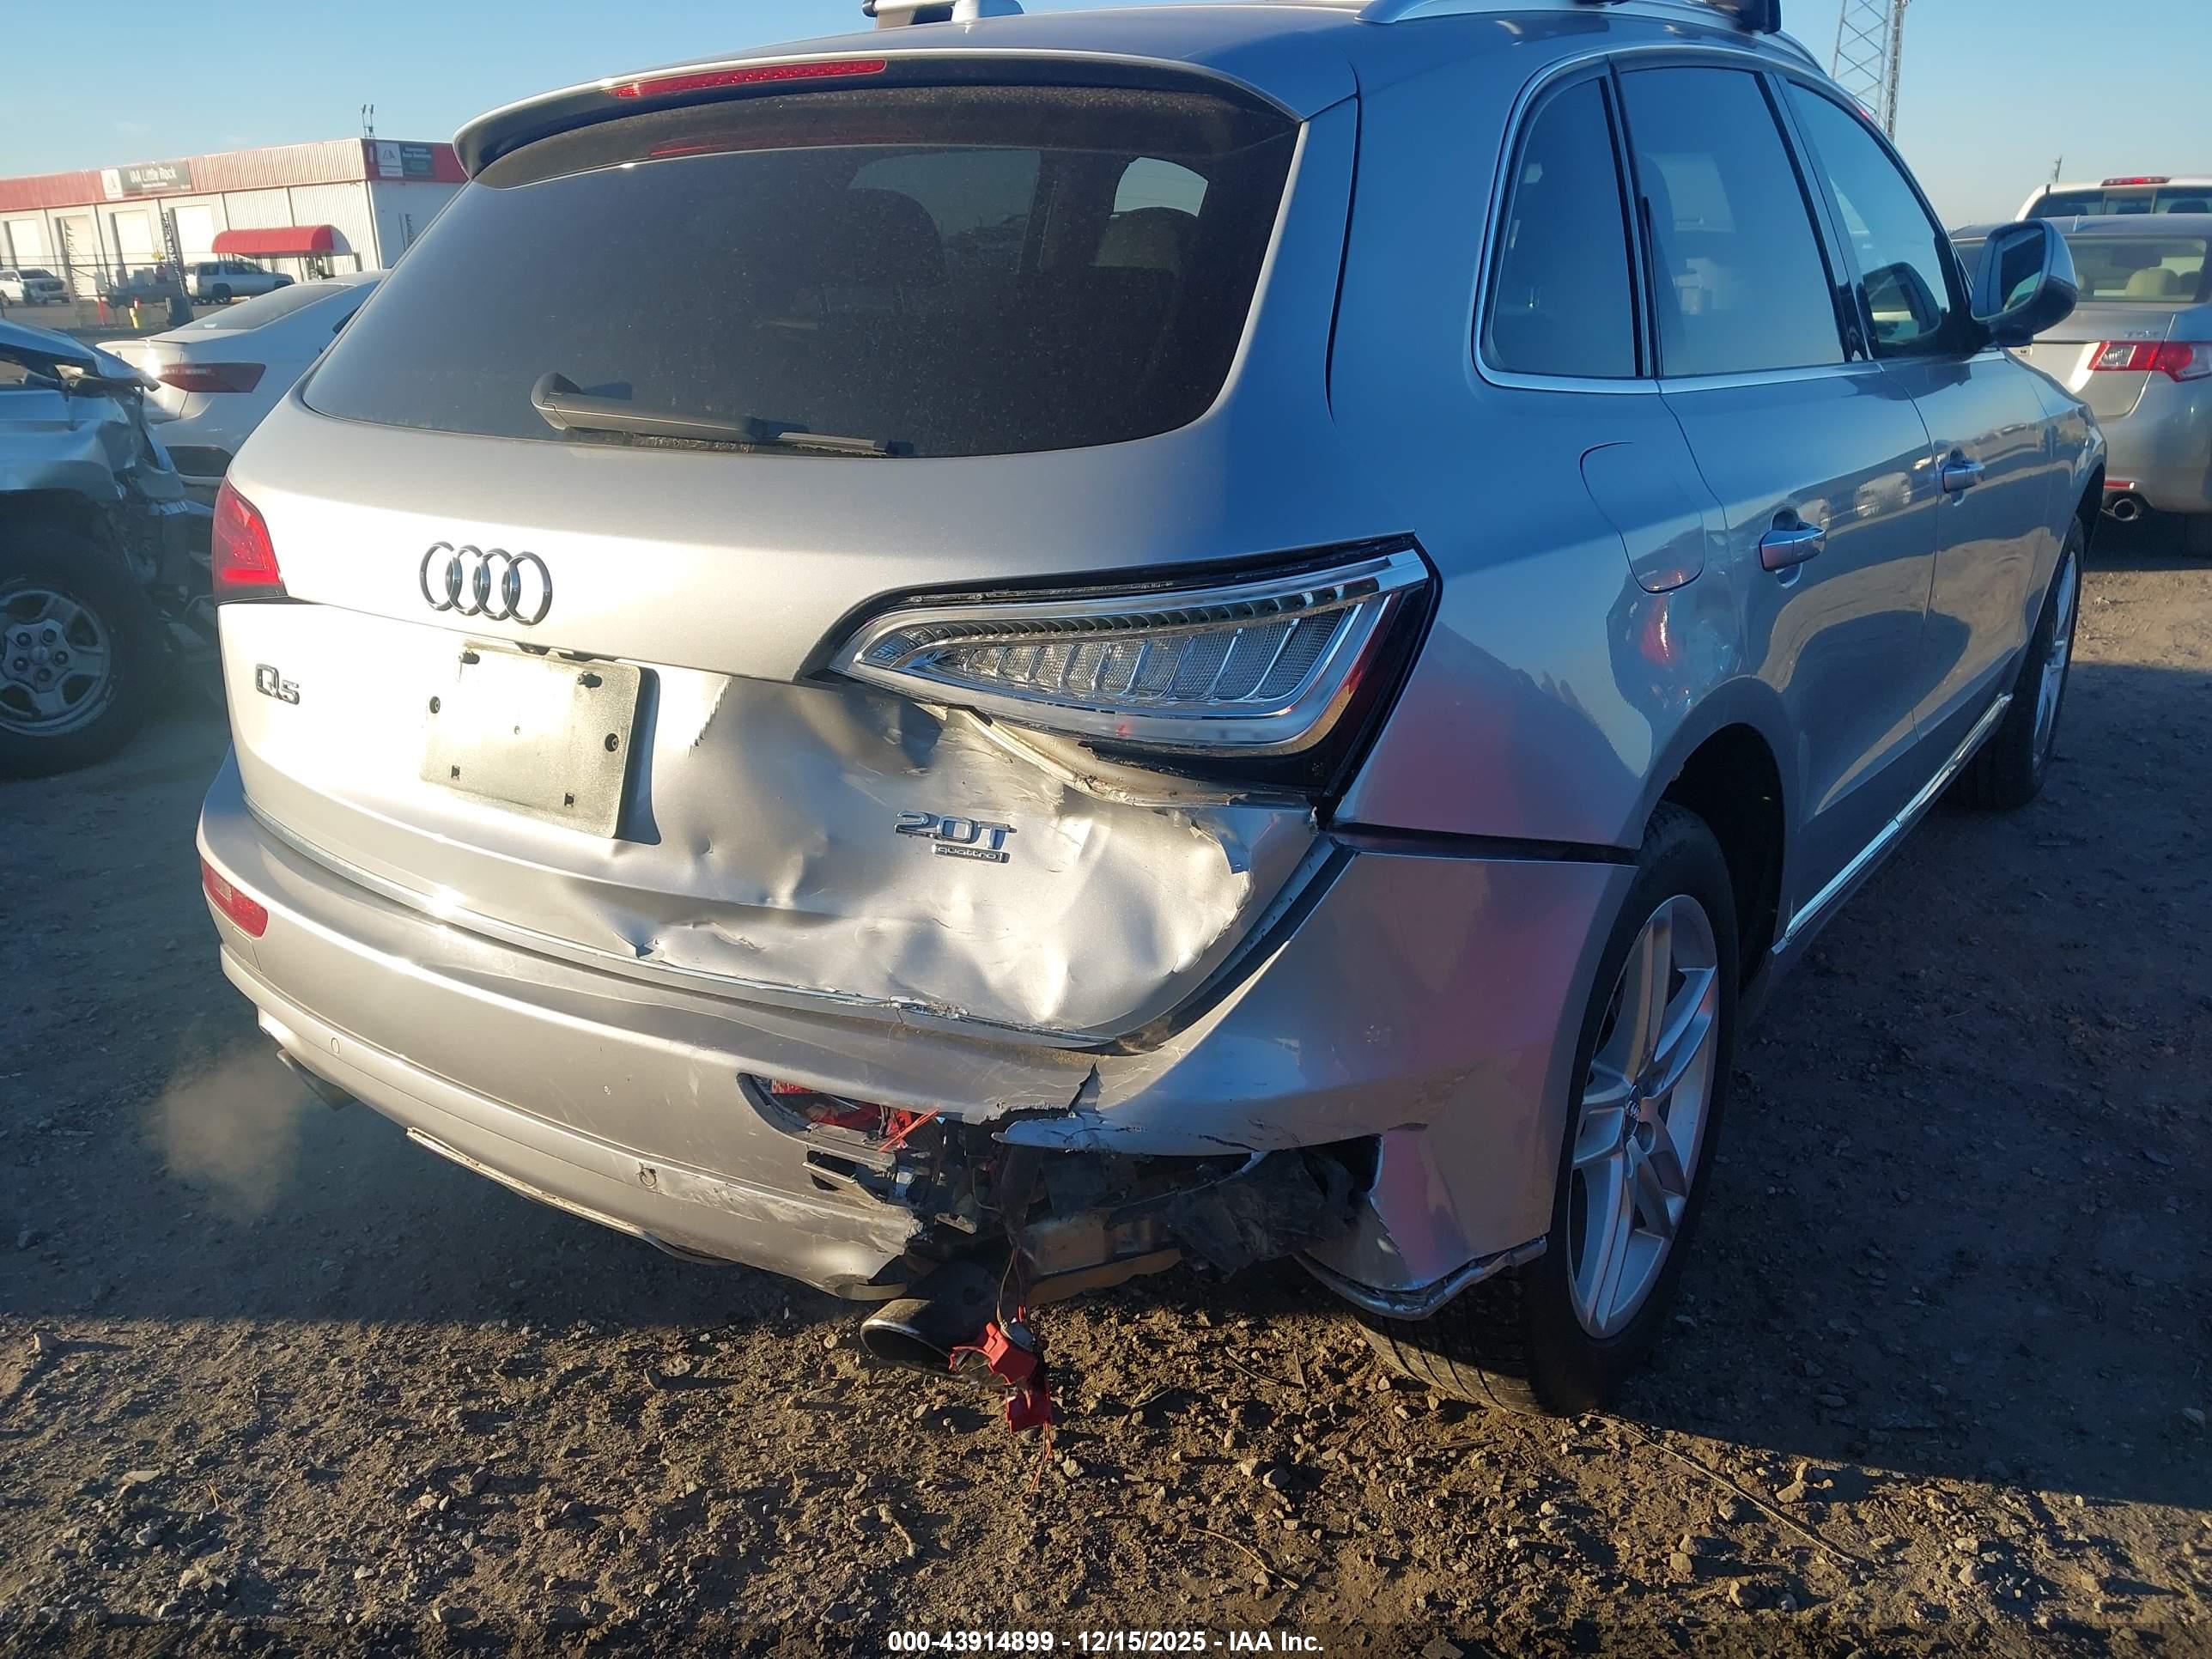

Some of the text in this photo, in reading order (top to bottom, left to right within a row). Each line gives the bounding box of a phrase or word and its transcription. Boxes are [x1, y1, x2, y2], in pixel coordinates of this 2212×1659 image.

[159, 166, 177, 180] Rock
[255, 664, 300, 705] Q5
[936, 845, 999, 860] quattro
